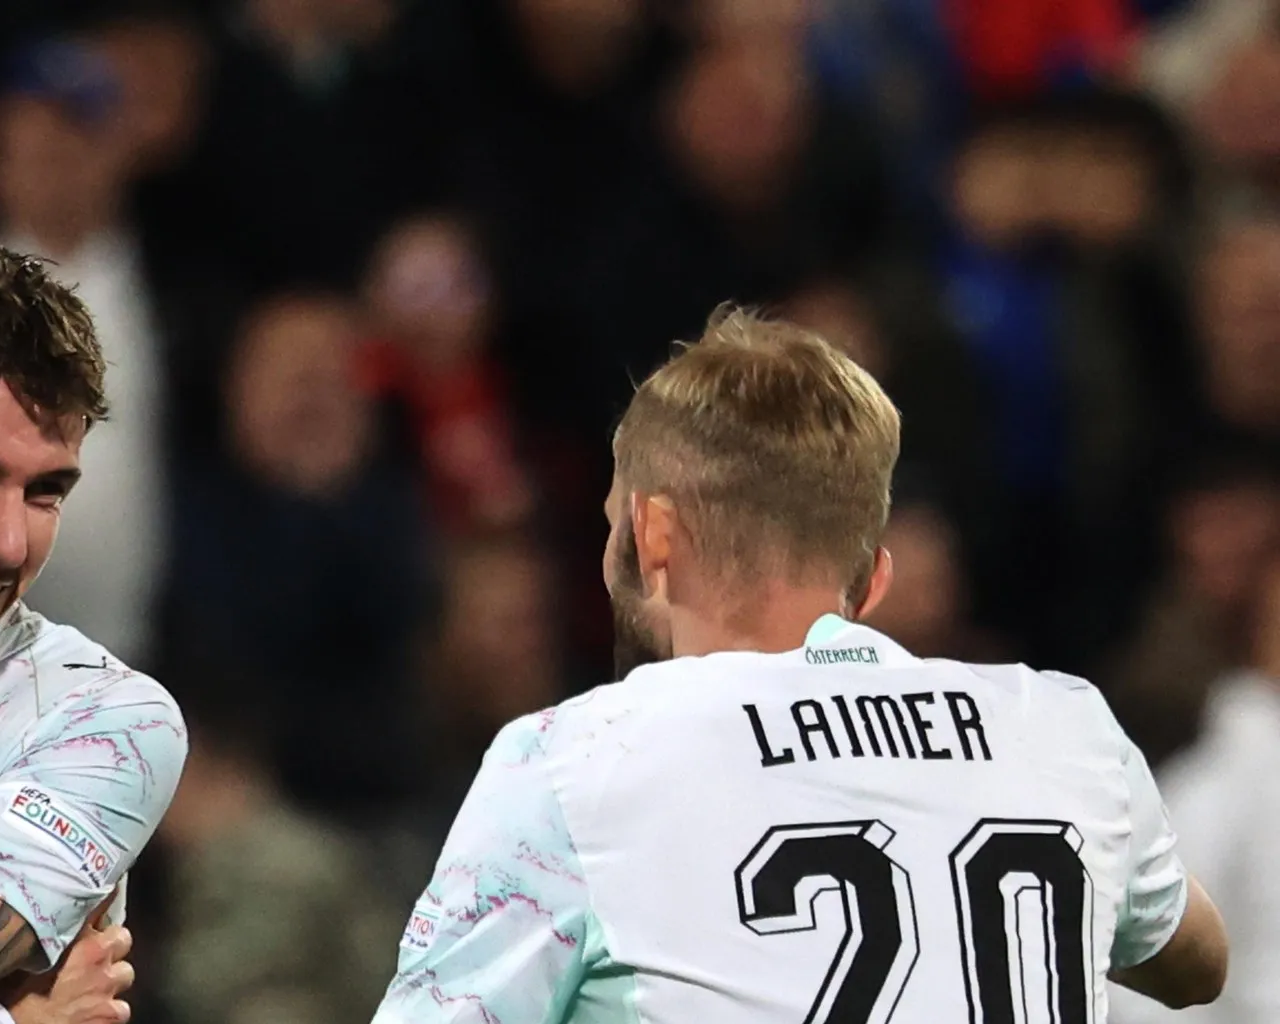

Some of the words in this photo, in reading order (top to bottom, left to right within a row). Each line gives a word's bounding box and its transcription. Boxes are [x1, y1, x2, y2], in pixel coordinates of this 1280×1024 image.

[804, 645, 880, 665] ÖSTERREICH
[743, 691, 993, 768] LAIMER
[20, 785, 52, 807] UEFA
